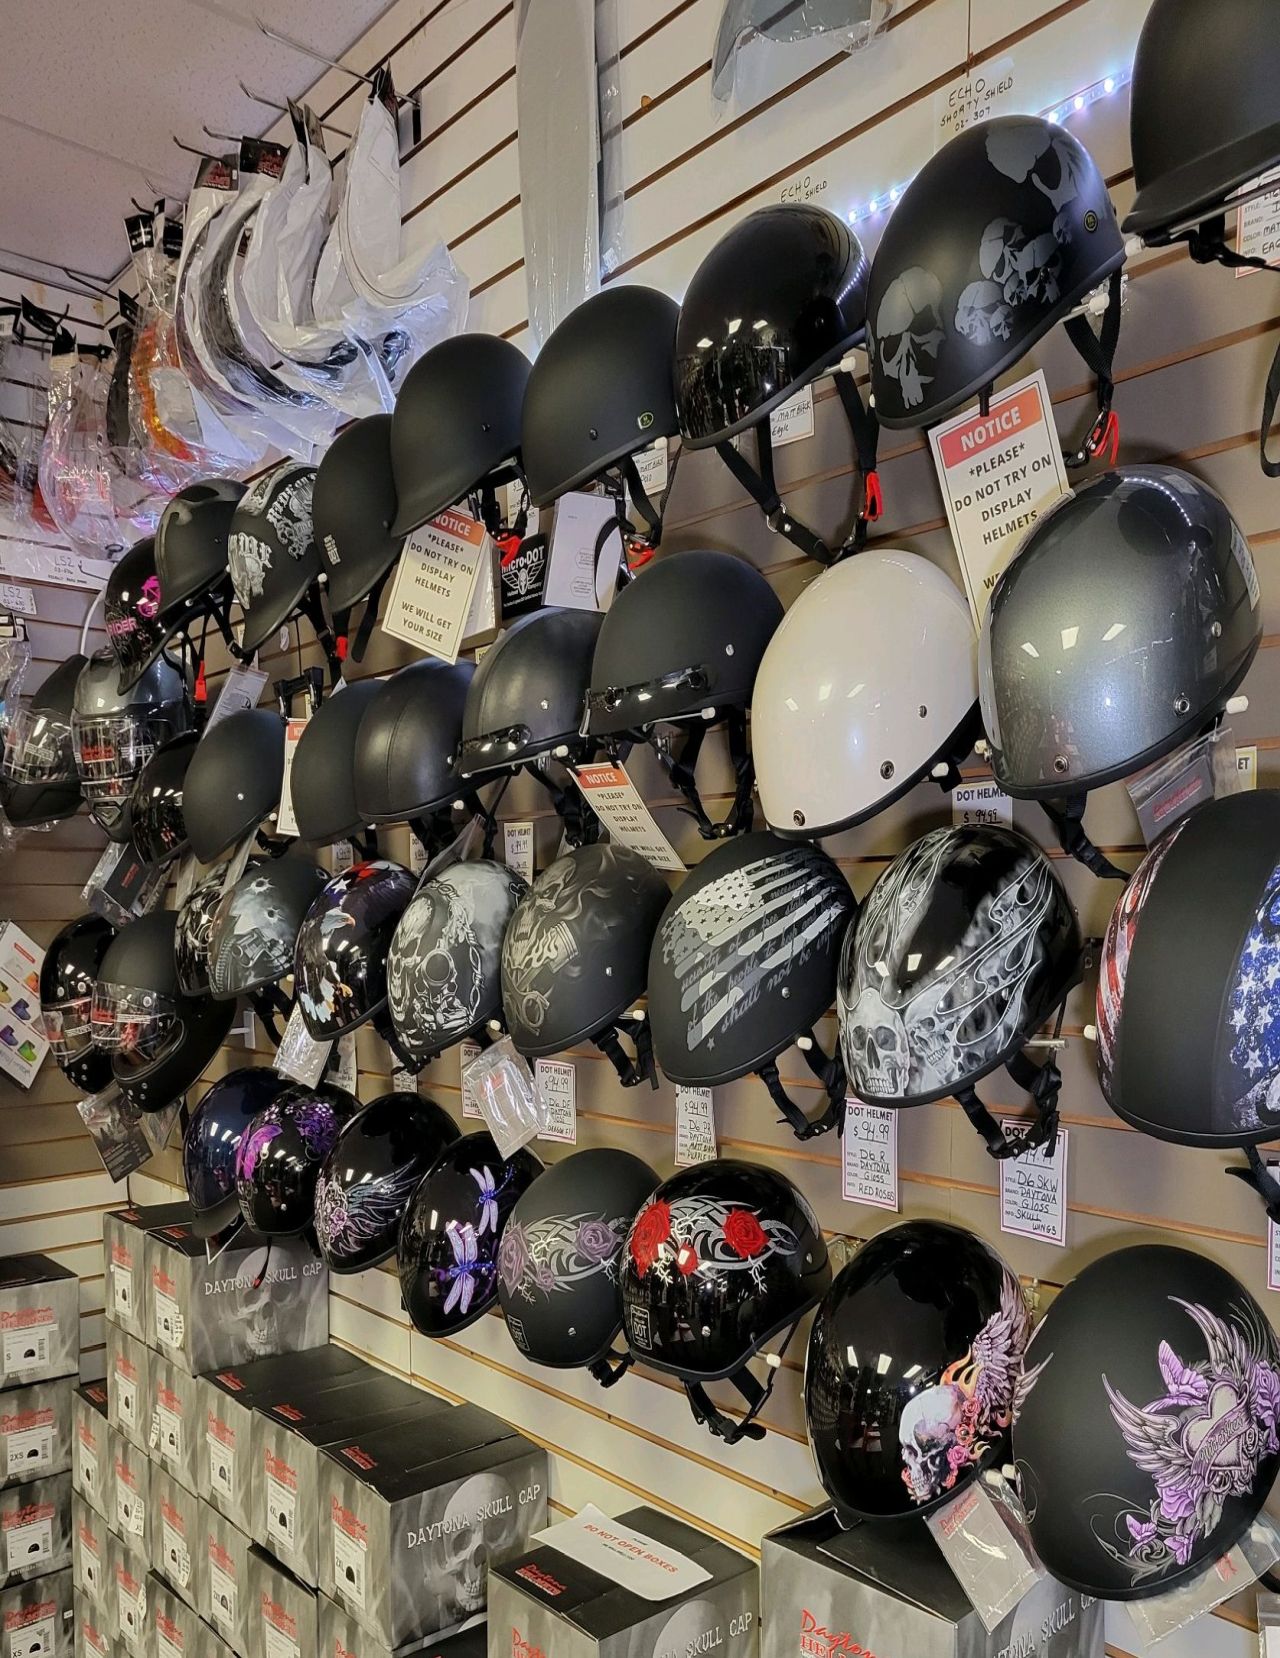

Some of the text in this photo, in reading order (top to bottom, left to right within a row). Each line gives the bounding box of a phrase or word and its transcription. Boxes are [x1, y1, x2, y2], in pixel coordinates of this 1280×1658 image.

[949, 78, 985, 107] ECHO
[984, 77, 1013, 101] SHIELD
[781, 176, 810, 203] ECHO
[960, 406, 1021, 452] NOTICE
[954, 454, 1052, 512] DO NOT TRY ON
[981, 488, 1032, 522] DISPLAY
[982, 510, 1038, 545] HELMETS
[410, 542, 474, 576] DO NOT TRY ON
[421, 563, 455, 584] DISPLAY
[415, 576, 451, 598] HELMETS
[401, 601, 452, 630] WE WILL GET
[403, 617, 443, 643] YOUR SIZE
[585, 772, 619, 785] NOTICE
[957, 790, 975, 801] DOT
[606, 804, 618, 812] NOT
[619, 804, 631, 812] TRY
[632, 803, 643, 811] ON
[541, 1066, 572, 1077] DOT HELMET
[848, 1106, 893, 1121] DOT HELMET
[853, 1121, 890, 1140] $ 94.99
[1005, 1125, 1026, 1138] DOT
[860, 1160, 891, 1175] DAYTONA
[859, 1182, 875, 1196] RED
[1019, 1186, 1057, 1204] DAYTONA
[1015, 1209, 1042, 1222] SKULL
[1032, 1223, 1057, 1236] WINGS
[264, 1267, 298, 1284] SKULL
[302, 1262, 322, 1277] CAP
[10, 1451, 24, 1462] 2XS
[407, 1484, 541, 1549] DAYTONA SKULL CAP
[584, 1524, 599, 1533] DO
[598, 1531, 620, 1542] NOT
[618, 1540, 645, 1556] OPEN
[644, 1553, 678, 1573] BOXES
[1041, 1598, 1076, 1643] SKULL
[686, 1626, 723, 1658] SKULL
[729, 1611, 752, 1637] CAP
